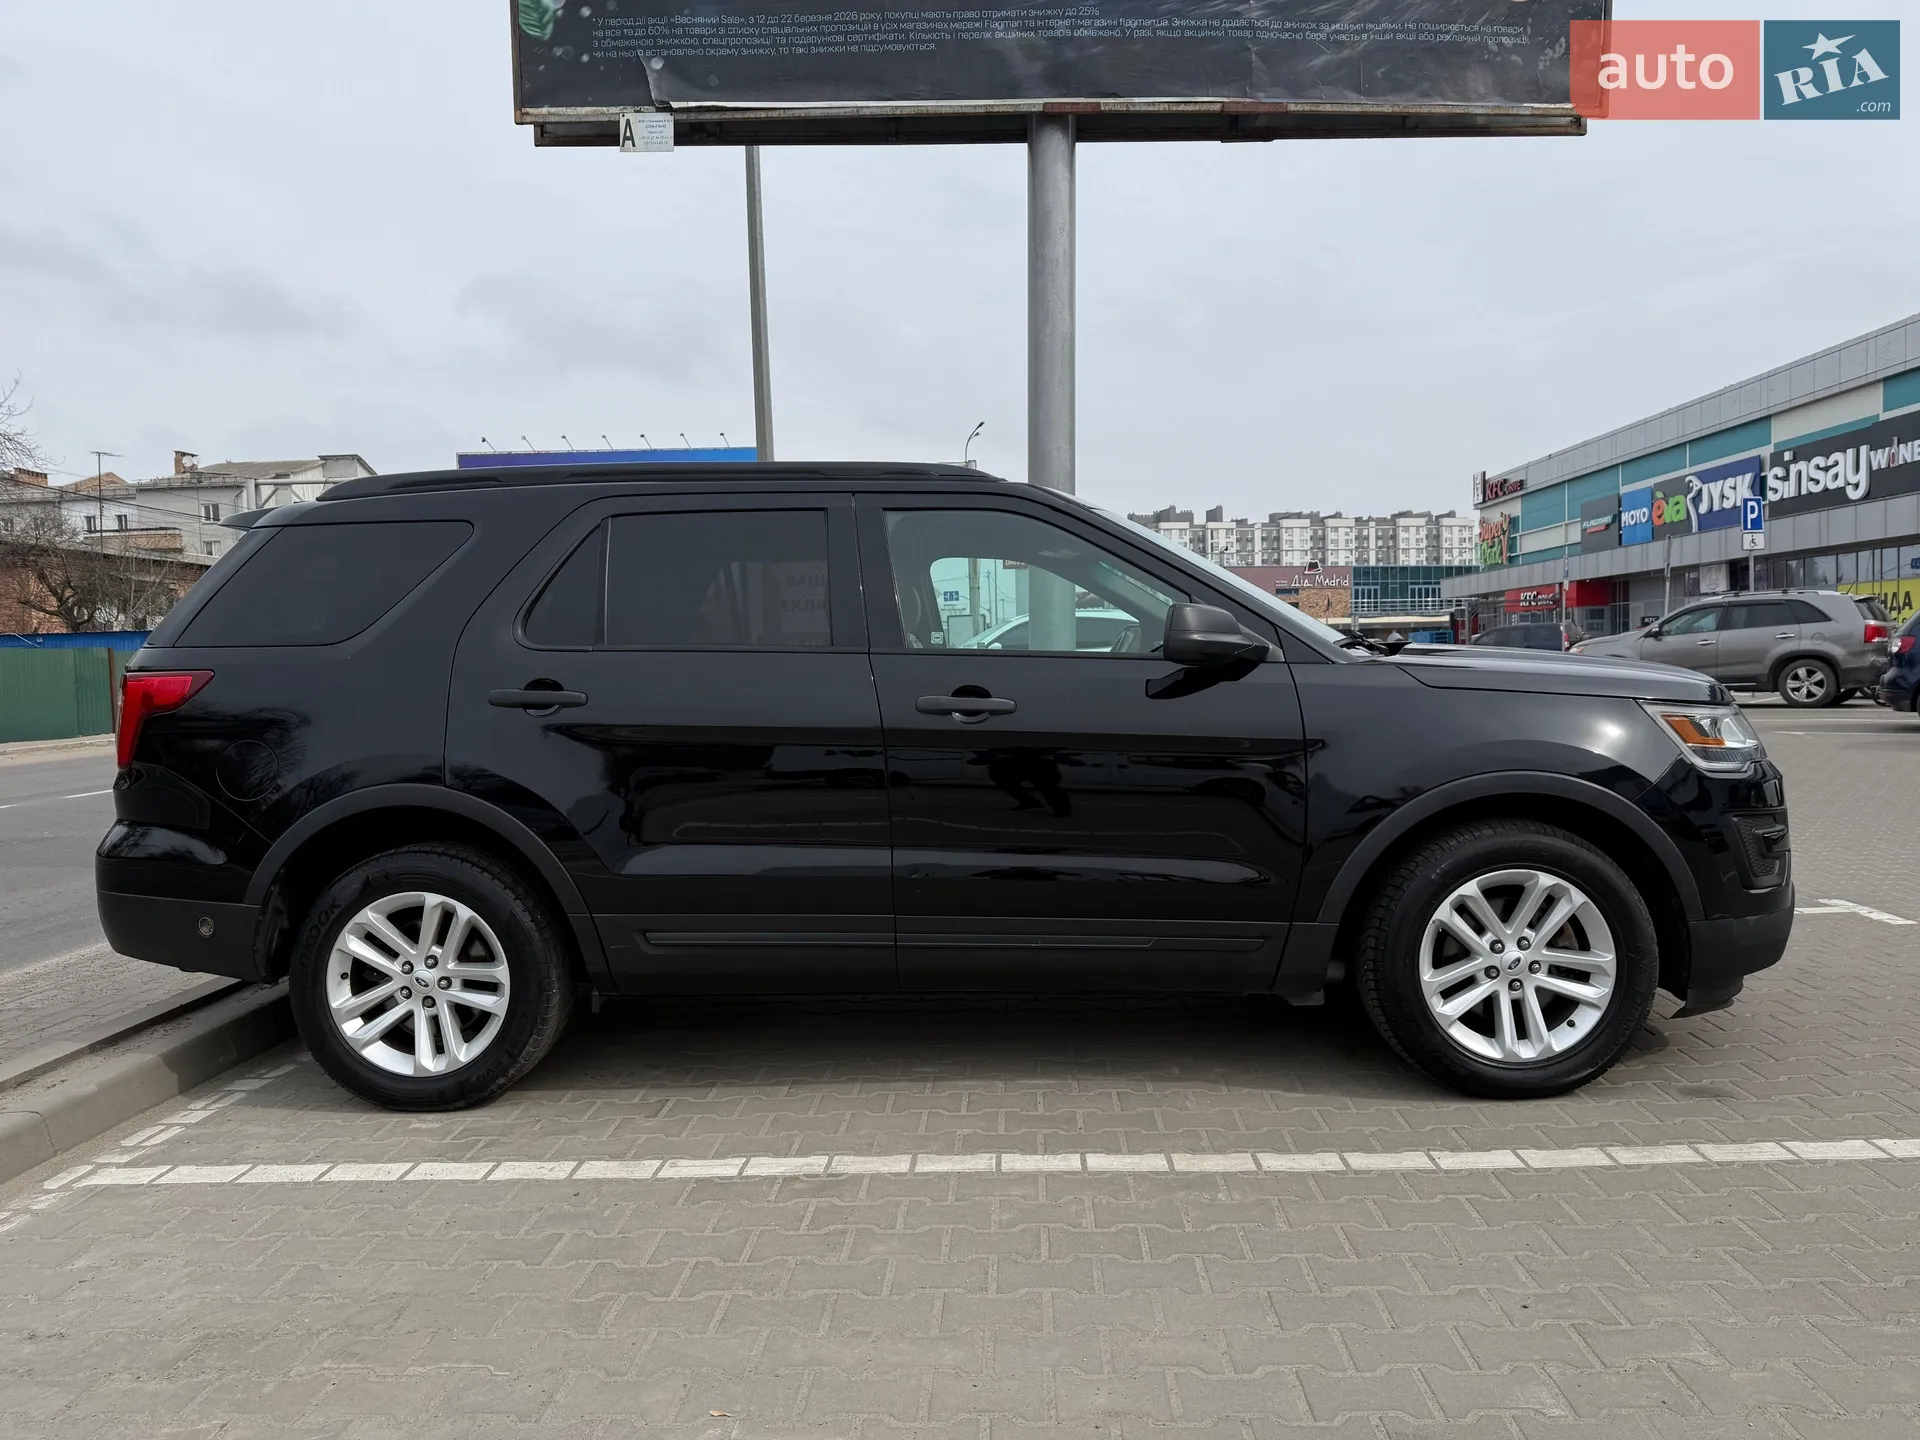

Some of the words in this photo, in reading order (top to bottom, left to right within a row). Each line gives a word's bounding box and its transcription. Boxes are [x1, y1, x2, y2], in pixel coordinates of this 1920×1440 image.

[592, 29, 604, 37] на
[634, 28, 646, 37] до
[648, 26, 670, 35] 60%
[672, 27, 683, 35] на
[684, 26, 717, 36] товари
[718, 24, 726, 34] зі
[727, 25, 760, 35] списку
[762, 22, 818, 34] спеціальних
[820, 21, 872, 33] пропозицій
[880, 21, 898, 32] усіх
[900, 21, 949, 30] магазинах
[950, 19, 983, 31] мережі
[984, 18, 1023, 30] Flagman
[1172, 17, 1208, 26] Знижка
[1222, 19, 1270, 28] додається
[1270, 20, 1283, 29] до
[1284, 21, 1318, 30] знижок
[1318, 22, 1330, 30] за
[1404, 22, 1416, 31] Не
[1418, 24, 1480, 34] поширюється
[1494, 25, 1524, 35] товари
[605, 15, 634, 27] період
[636, 15, 646, 26] дії
[648, 15, 668, 25] акції
[670, 14, 720, 24] «Весняний
[756, 13, 766, 22] 12
[766, 14, 780, 23] до
[780, 12, 793, 21] 22
[794, 11, 832, 23] березня
[834, 11, 858, 20] 2026
[884, 10, 920, 21] покупці
[920, 11, 952, 19] мають
[952, 10, 980, 20] право
[982, 9, 1028, 19] отримати
[1028, 9, 1064, 18] знижку
[1065, 8, 1077, 17] до
[1078, 6, 1100, 15] 25%
[600, 36, 654, 47] обмеженою
[788, 32, 845, 44] подарункові
[847, 30, 907, 43] сертифікати.
[909, 30, 951, 39] Кількість
[957, 29, 992, 40] перелік
[994, 28, 1035, 39] акційних
[1074, 28, 1123, 37] обмежено.
[1124, 28, 1132, 37] У
[1156, 30, 1182, 38] якщо
[1184, 28, 1225, 38] акційний
[1227, 30, 1254, 40] товар
[1255, 31, 1304, 40] одночасно
[1306, 30, 1327, 42] бере
[1329, 32, 1360, 42] участь
[1369, 31, 1394, 40] іншій
[1396, 31, 1416, 42] акції
[1418, 32, 1434, 41] або
[1436, 32, 1481, 44] рекламній
[646, 48, 704, 56] встановлено
[790, 44, 809, 53] такі
[810, 45, 846, 53] знижки
[860, 41, 937, 54] підсумовуються.
[1768, 444, 1871, 501] sinsay
[1485, 478, 1505, 501] KFC
[1698, 472, 1756, 514] JYSK
[1582, 515, 1613, 529] FLAGMAN
[1621, 507, 1650, 528] MOYO
[1746, 501, 1759, 529] P
[1479, 516, 1503, 547] Super
[1520, 590, 1537, 606] KFC
